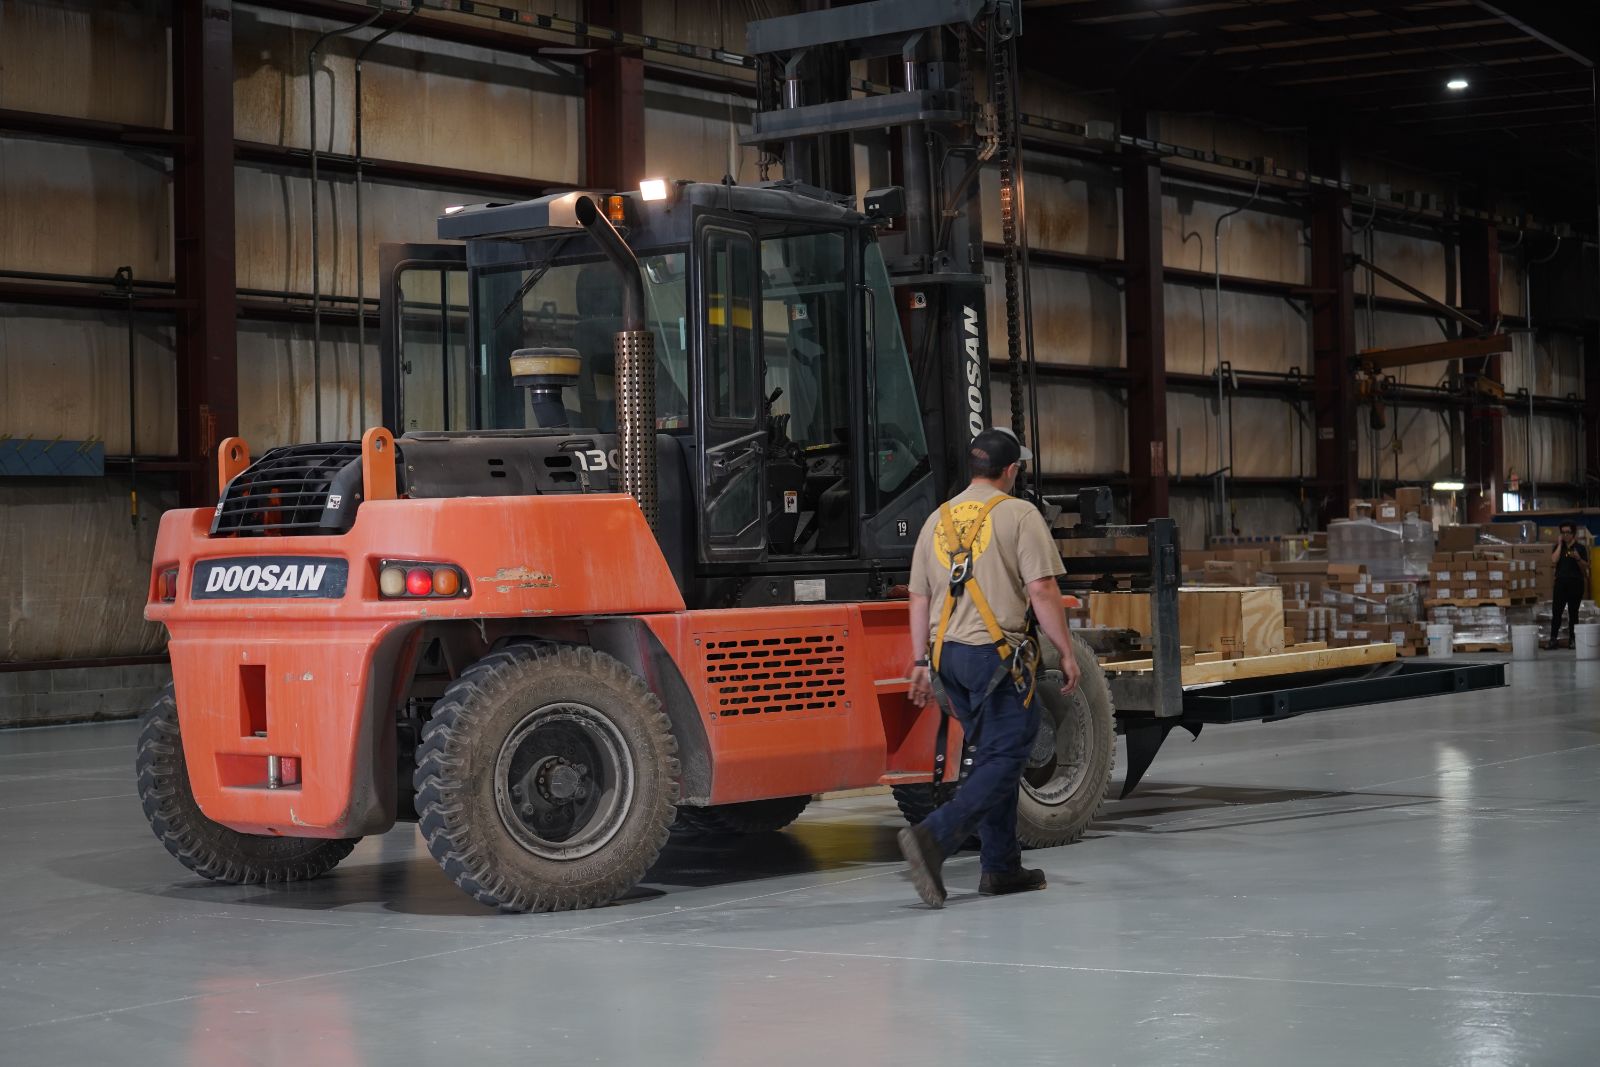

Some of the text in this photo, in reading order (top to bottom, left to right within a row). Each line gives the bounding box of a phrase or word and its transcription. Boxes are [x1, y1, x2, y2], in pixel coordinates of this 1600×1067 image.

[963, 305, 984, 444] OOSAN
[898, 521, 907, 532] 19
[205, 565, 327, 592] DOOSAN
